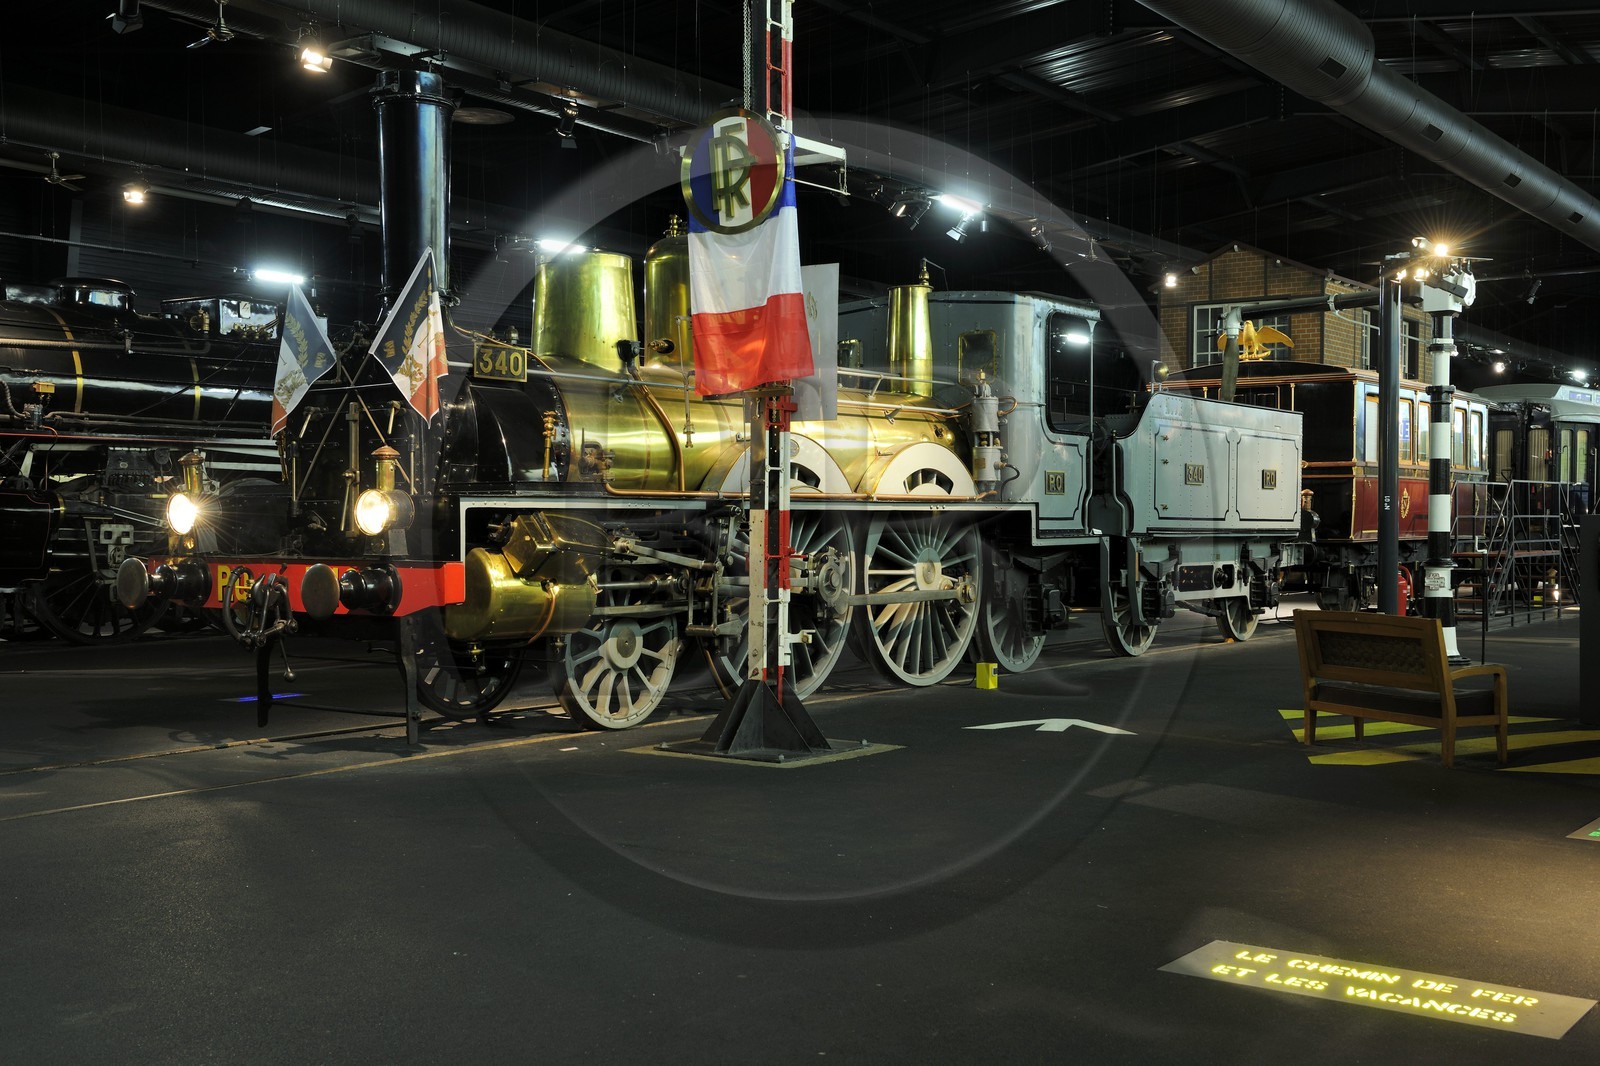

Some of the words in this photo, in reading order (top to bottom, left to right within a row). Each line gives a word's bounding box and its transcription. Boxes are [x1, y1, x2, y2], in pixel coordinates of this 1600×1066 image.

[479, 348, 523, 376] 340
[1187, 465, 1203, 482] 340
[1211, 964, 1257, 978] ET
[1264, 973, 1329, 991] LES
[1346, 985, 1518, 1024] VACANCES
[1235, 950, 1278, 965] LE
[1287, 959, 1401, 984] CHEMIN
[1412, 979, 1458, 994] DE
[1471, 988, 1539, 1007] FER
